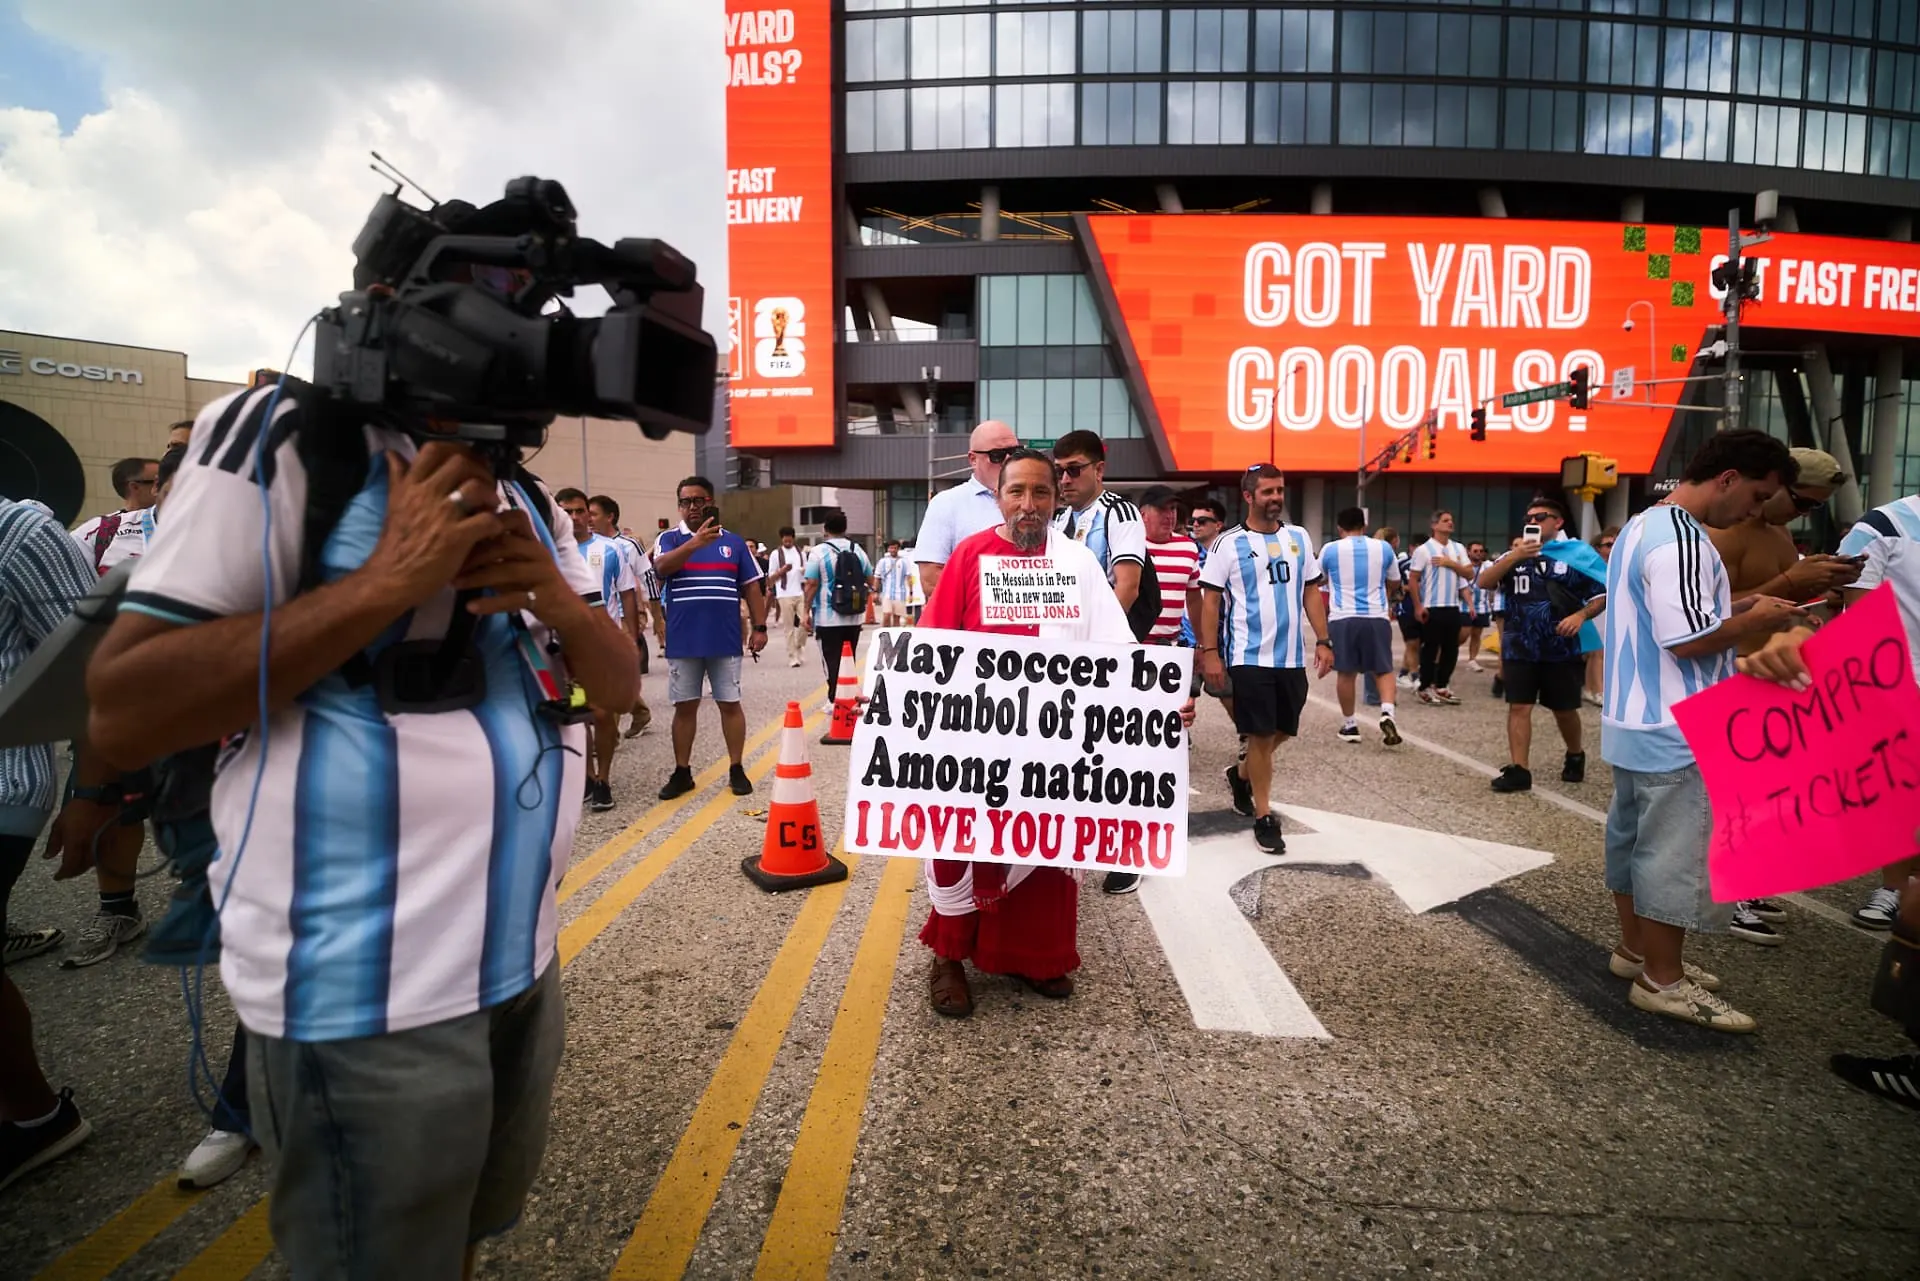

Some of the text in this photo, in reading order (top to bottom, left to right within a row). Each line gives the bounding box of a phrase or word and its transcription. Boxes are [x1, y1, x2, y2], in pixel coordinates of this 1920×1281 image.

[725, 9, 795, 47] YARD
[727, 167, 776, 195] FAST
[1243, 242, 1592, 329] GOT YARD
[1778, 258, 1857, 308] FAST
[29, 357, 144, 386] Cosm
[1226, 345, 1606, 433] GOOOALS?
[984, 572, 1077, 587] The Messiah is in Peru
[1266, 560, 1291, 585] 10
[1513, 575, 1530, 594] 10
[985, 604, 1080, 622] EZEQUIEL JONAS
[992, 587, 1065, 604] With a new name
[873, 631, 1182, 693] May soccer be
[863, 674, 1183, 753] A symbol of peace
[1726, 637, 1905, 763] COMPRO
[861, 735, 1176, 809] Among nations
[779, 821, 818, 851] CS
[855, 800, 1175, 869] I LOVE YOU PERU
